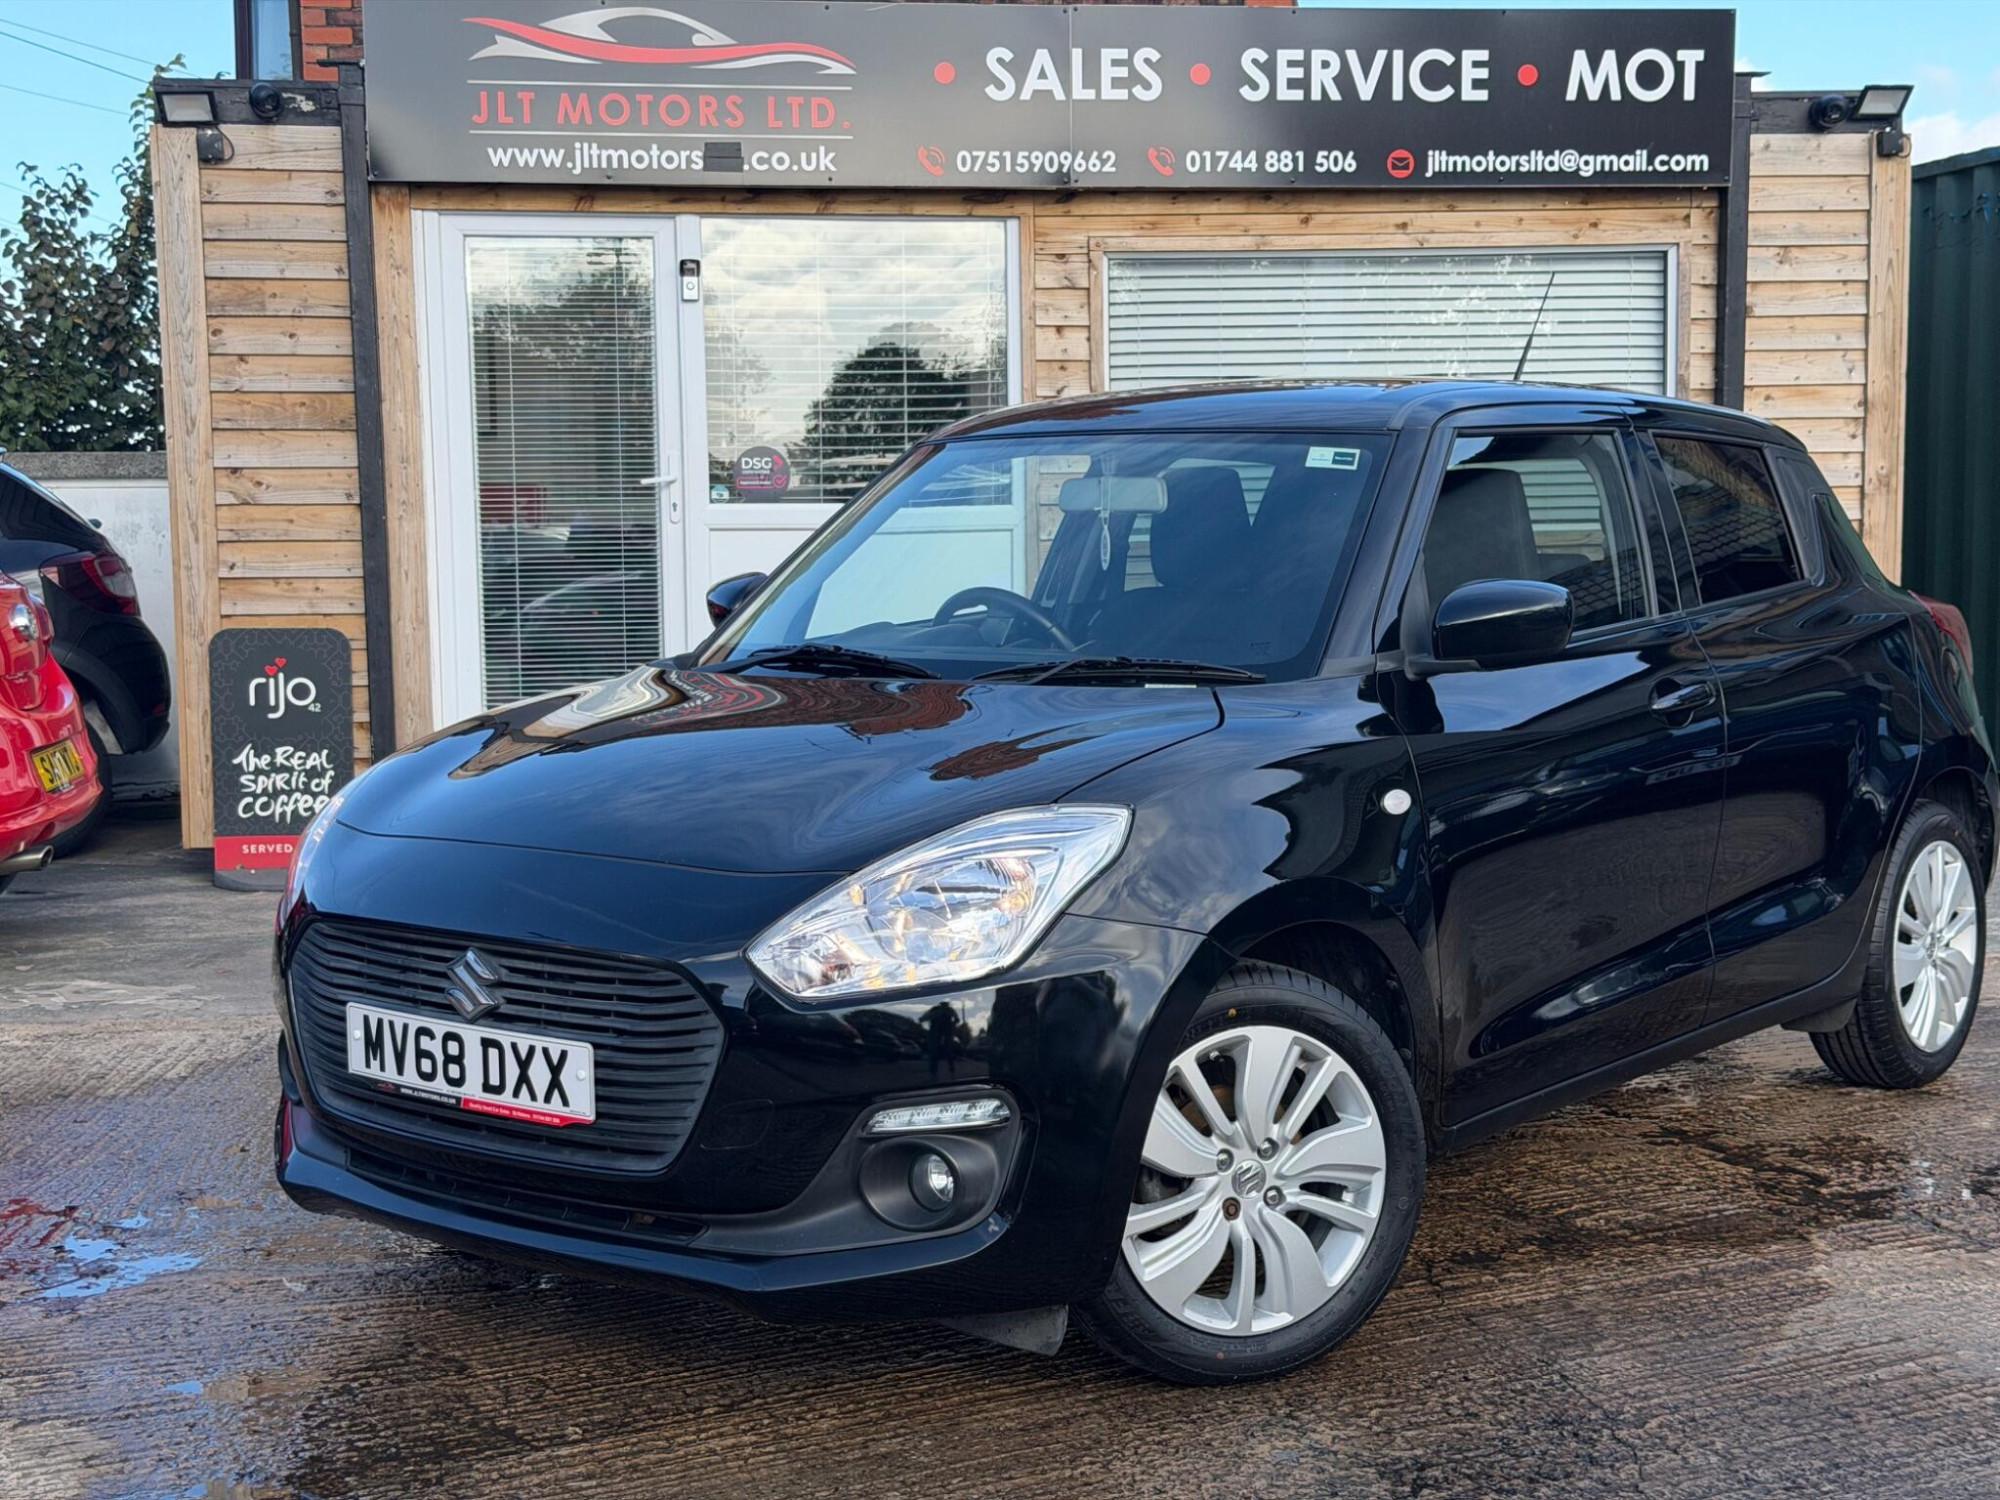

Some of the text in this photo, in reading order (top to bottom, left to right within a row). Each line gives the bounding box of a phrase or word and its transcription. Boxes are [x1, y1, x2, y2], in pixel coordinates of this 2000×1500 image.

[984, 46, 1163, 102] SALES
[1238, 47, 1490, 102] SERVICE
[1565, 47, 1706, 102] MOT
[472, 91, 535, 125] JLT
[557, 93, 746, 128] MOTORS
[956, 150, 1117, 173] 07515909662
[1185, 150, 1357, 173] 01744 881 506
[1424, 149, 1709, 177] jltmotorsltd@gmail.com
[741, 457, 773, 469] DSG
[242, 844, 294, 854] SERVED
[363, 1014, 570, 1108] MV68 DXX
